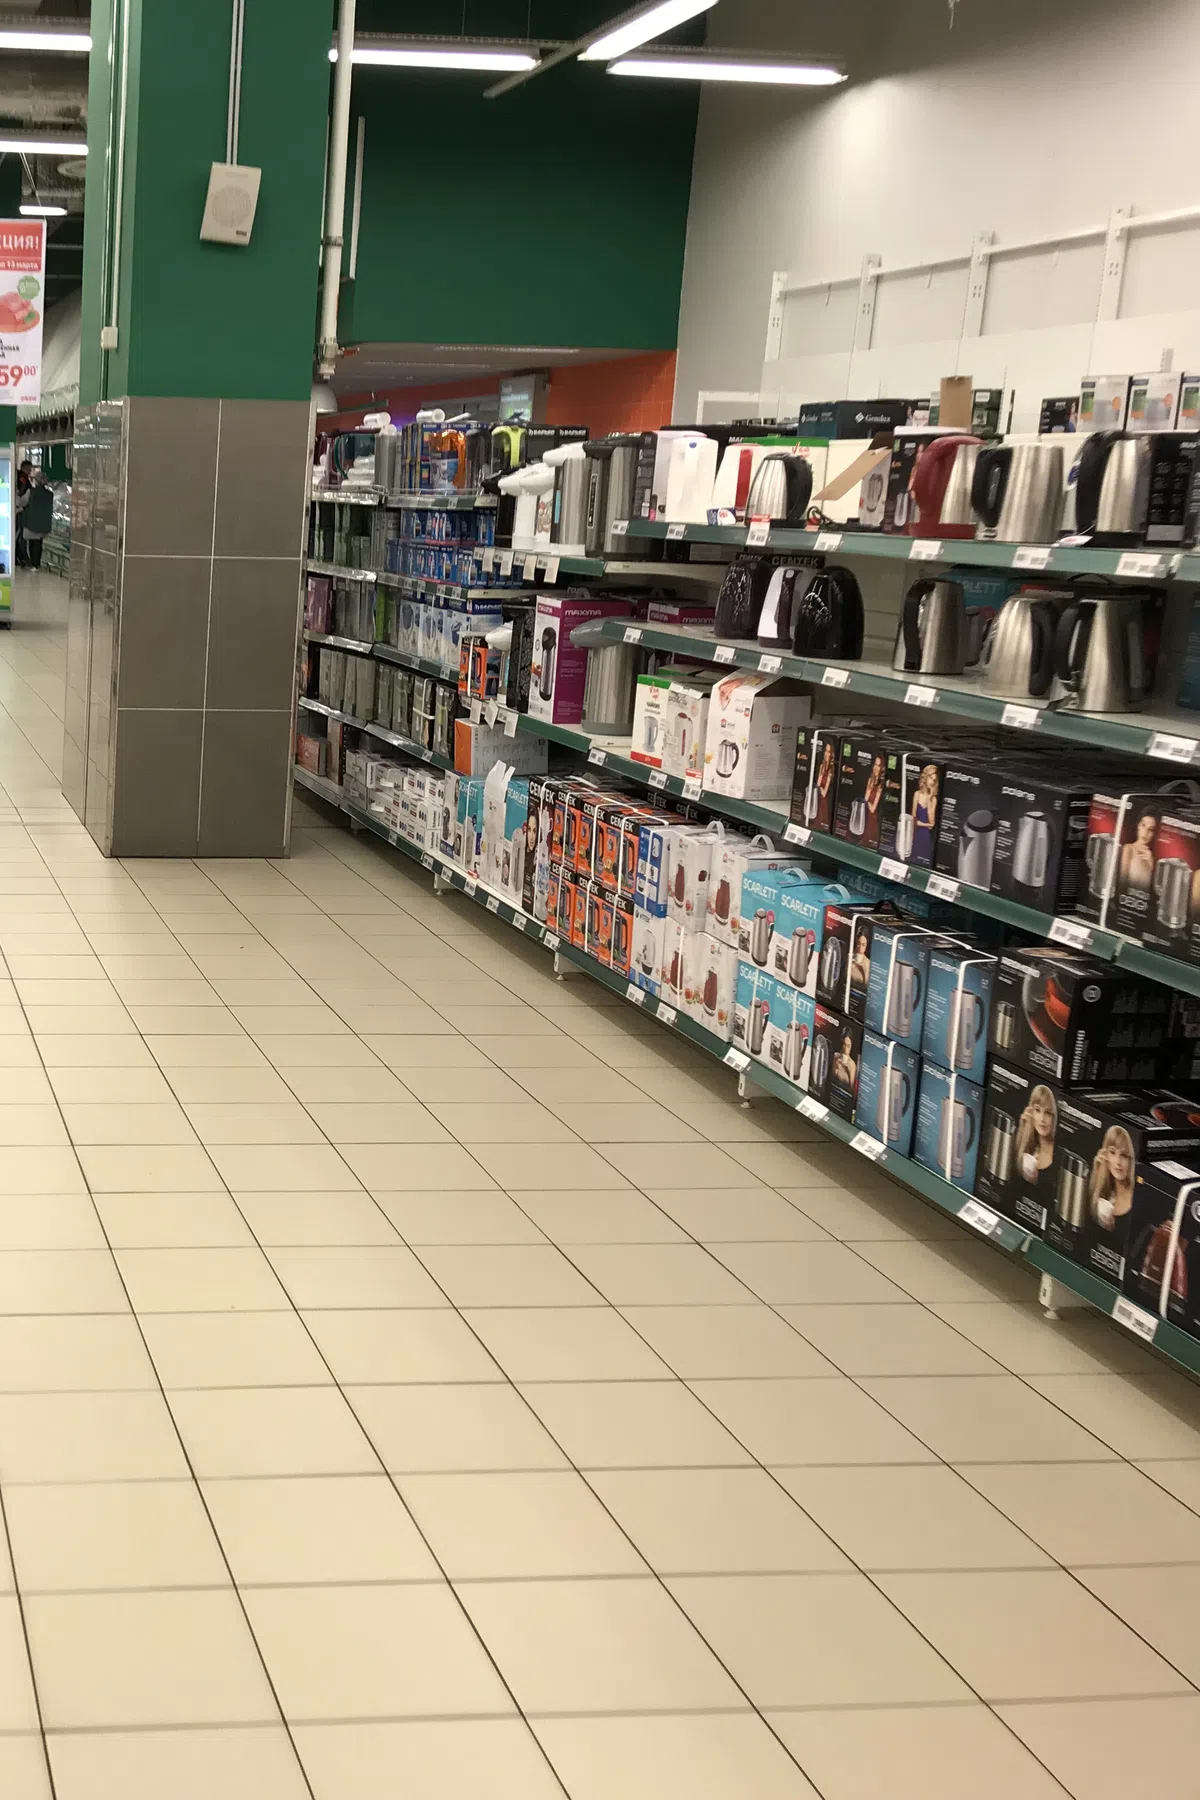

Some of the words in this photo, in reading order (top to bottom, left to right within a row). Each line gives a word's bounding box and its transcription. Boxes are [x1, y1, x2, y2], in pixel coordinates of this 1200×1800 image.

[583, 803, 605, 820] CENEK
[610, 815, 634, 832] CENEK
[743, 877, 778, 900] SCARLETT
[605, 891, 627, 910] CENEK
[781, 894, 820, 919] SCARLETT
[776, 985, 814, 1014] SCARETT
